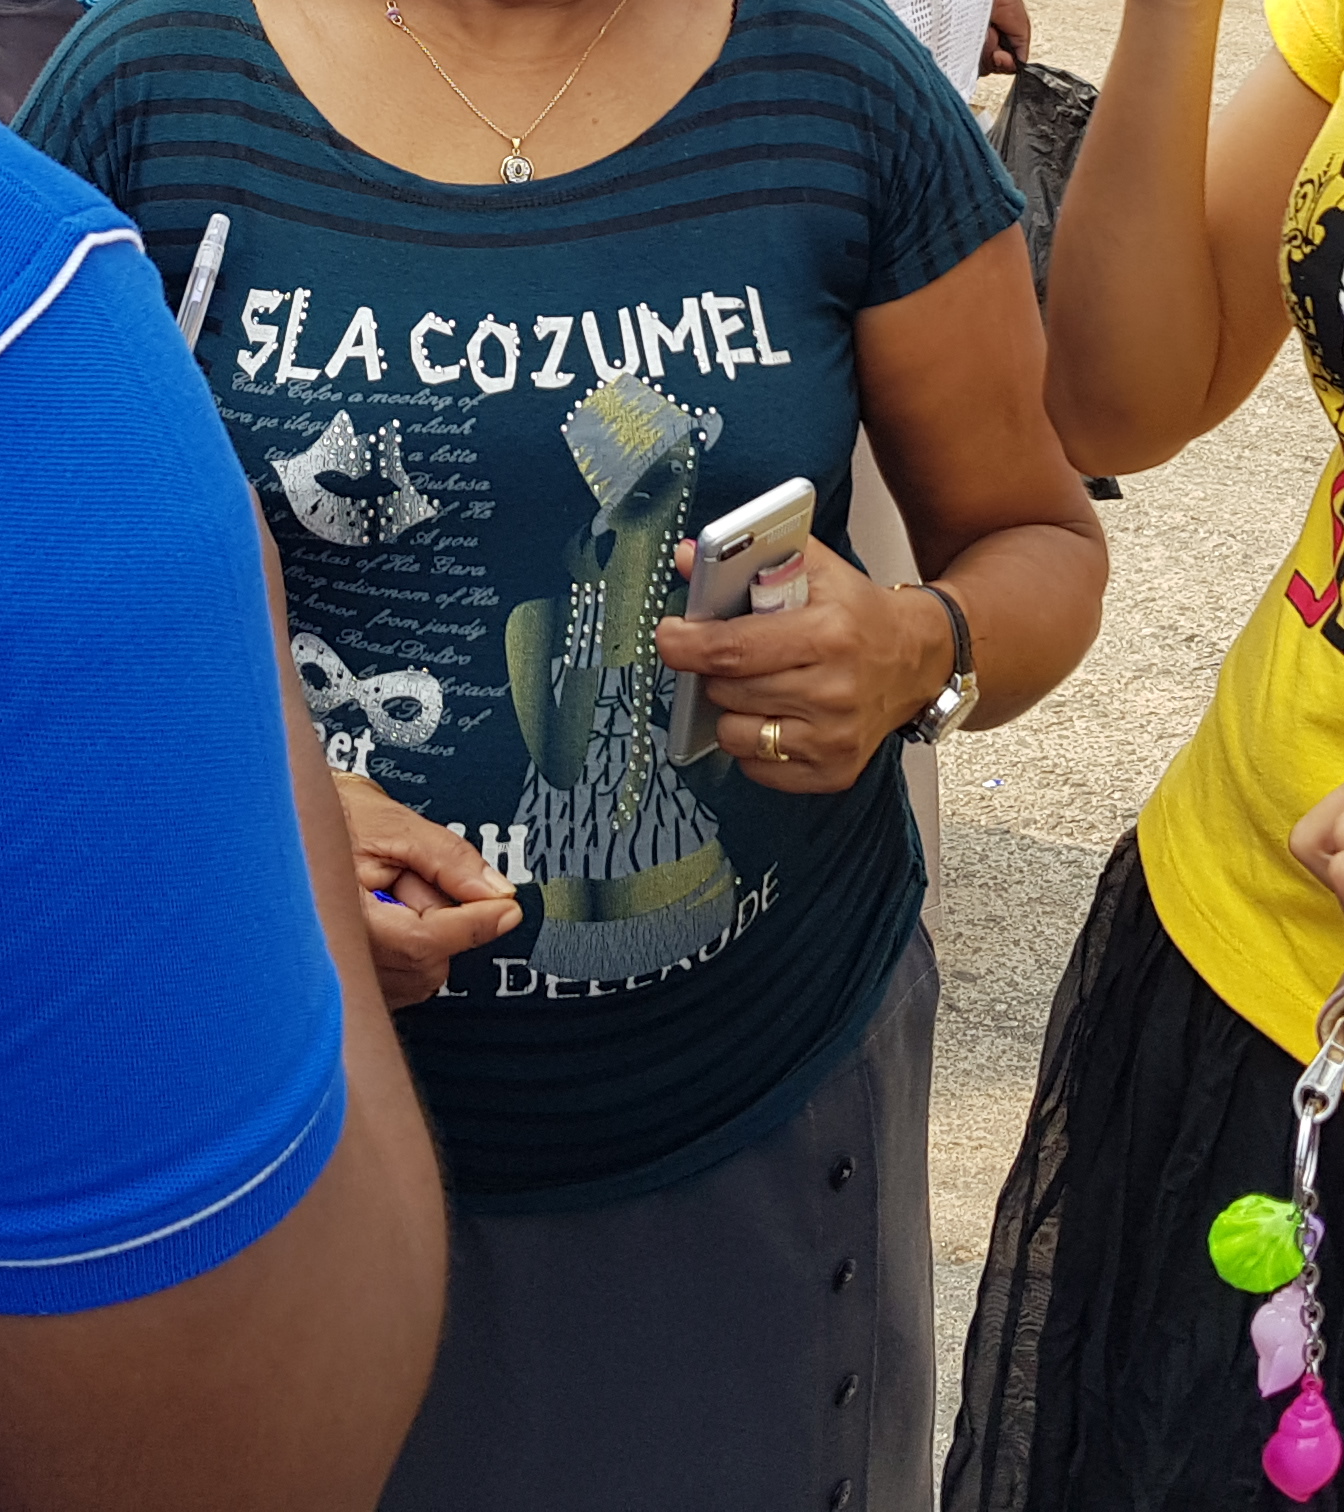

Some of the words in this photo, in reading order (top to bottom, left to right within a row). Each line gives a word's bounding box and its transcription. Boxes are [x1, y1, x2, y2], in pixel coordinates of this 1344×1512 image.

[237, 287, 388, 384] SLA
[409, 285, 791, 393] COZUMEL
[366, 389, 454, 412] meeting
[457, 391, 492, 414] of
[355, 552, 388, 574] of
[434, 587, 468, 610] of
[457, 707, 493, 733] of
